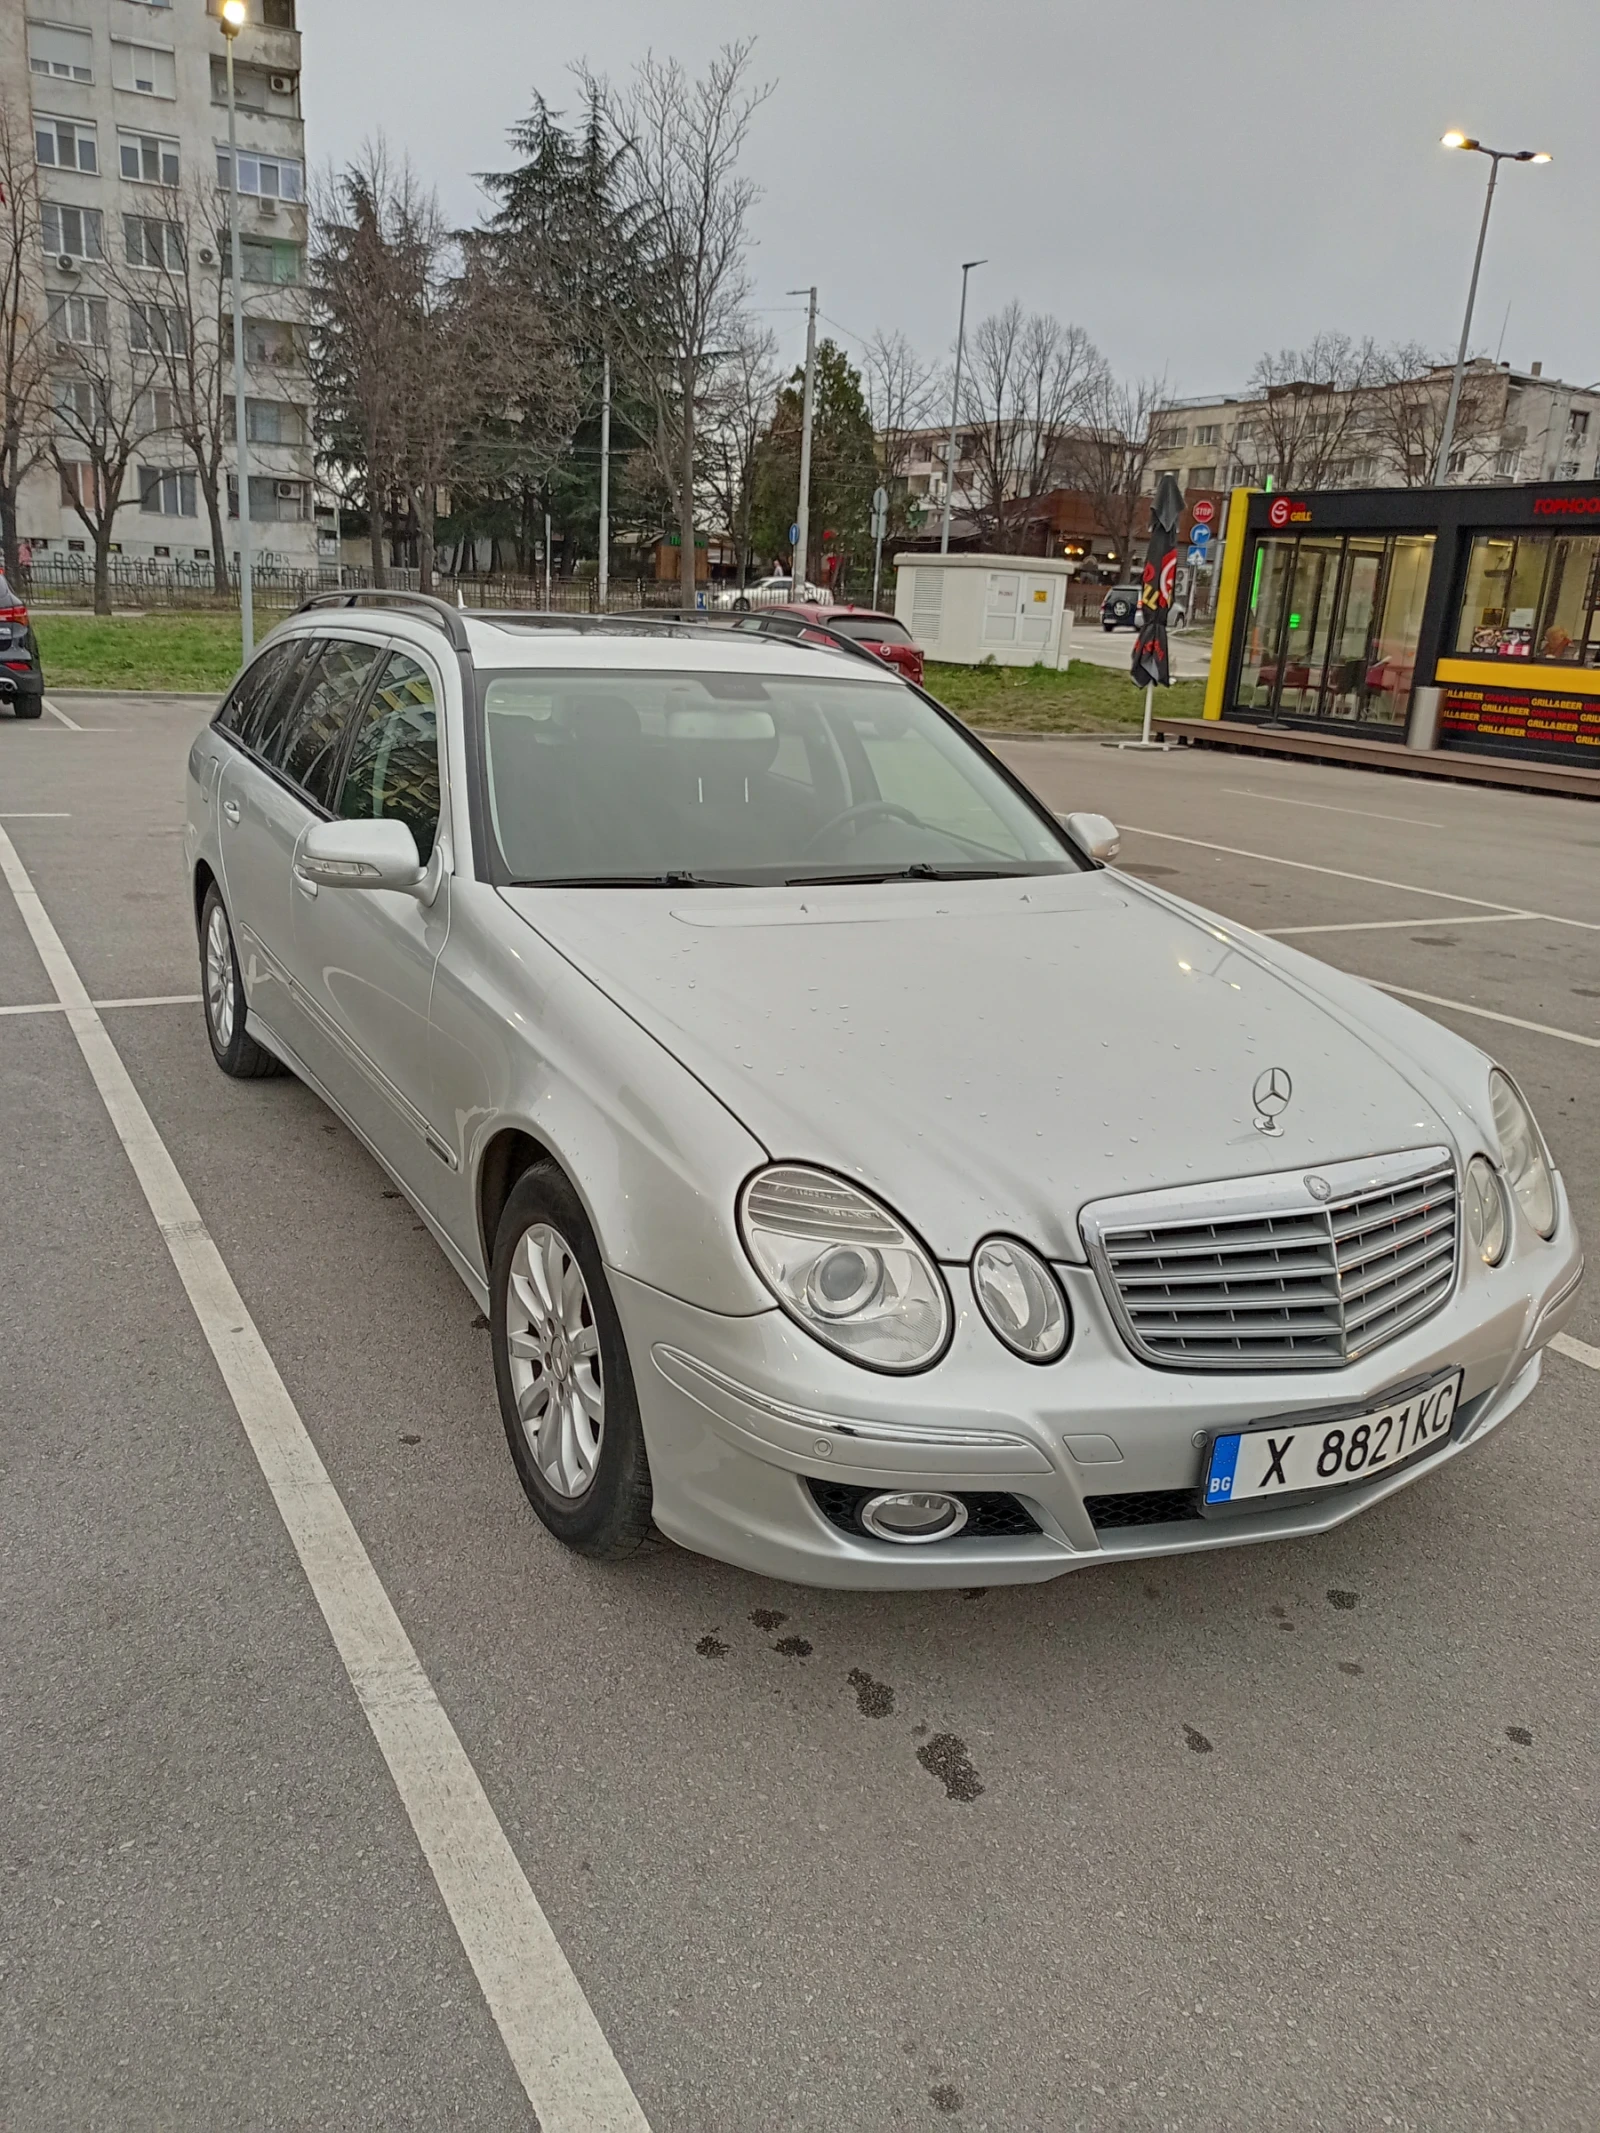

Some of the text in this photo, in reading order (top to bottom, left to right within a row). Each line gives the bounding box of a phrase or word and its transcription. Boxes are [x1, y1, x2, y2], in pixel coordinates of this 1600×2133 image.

[1195, 507, 1211, 516] STOP
[1291, 511, 1312, 521] GRILL
[1258, 1435, 1295, 1487] X
[1210, 1477, 1231, 1493] BG
